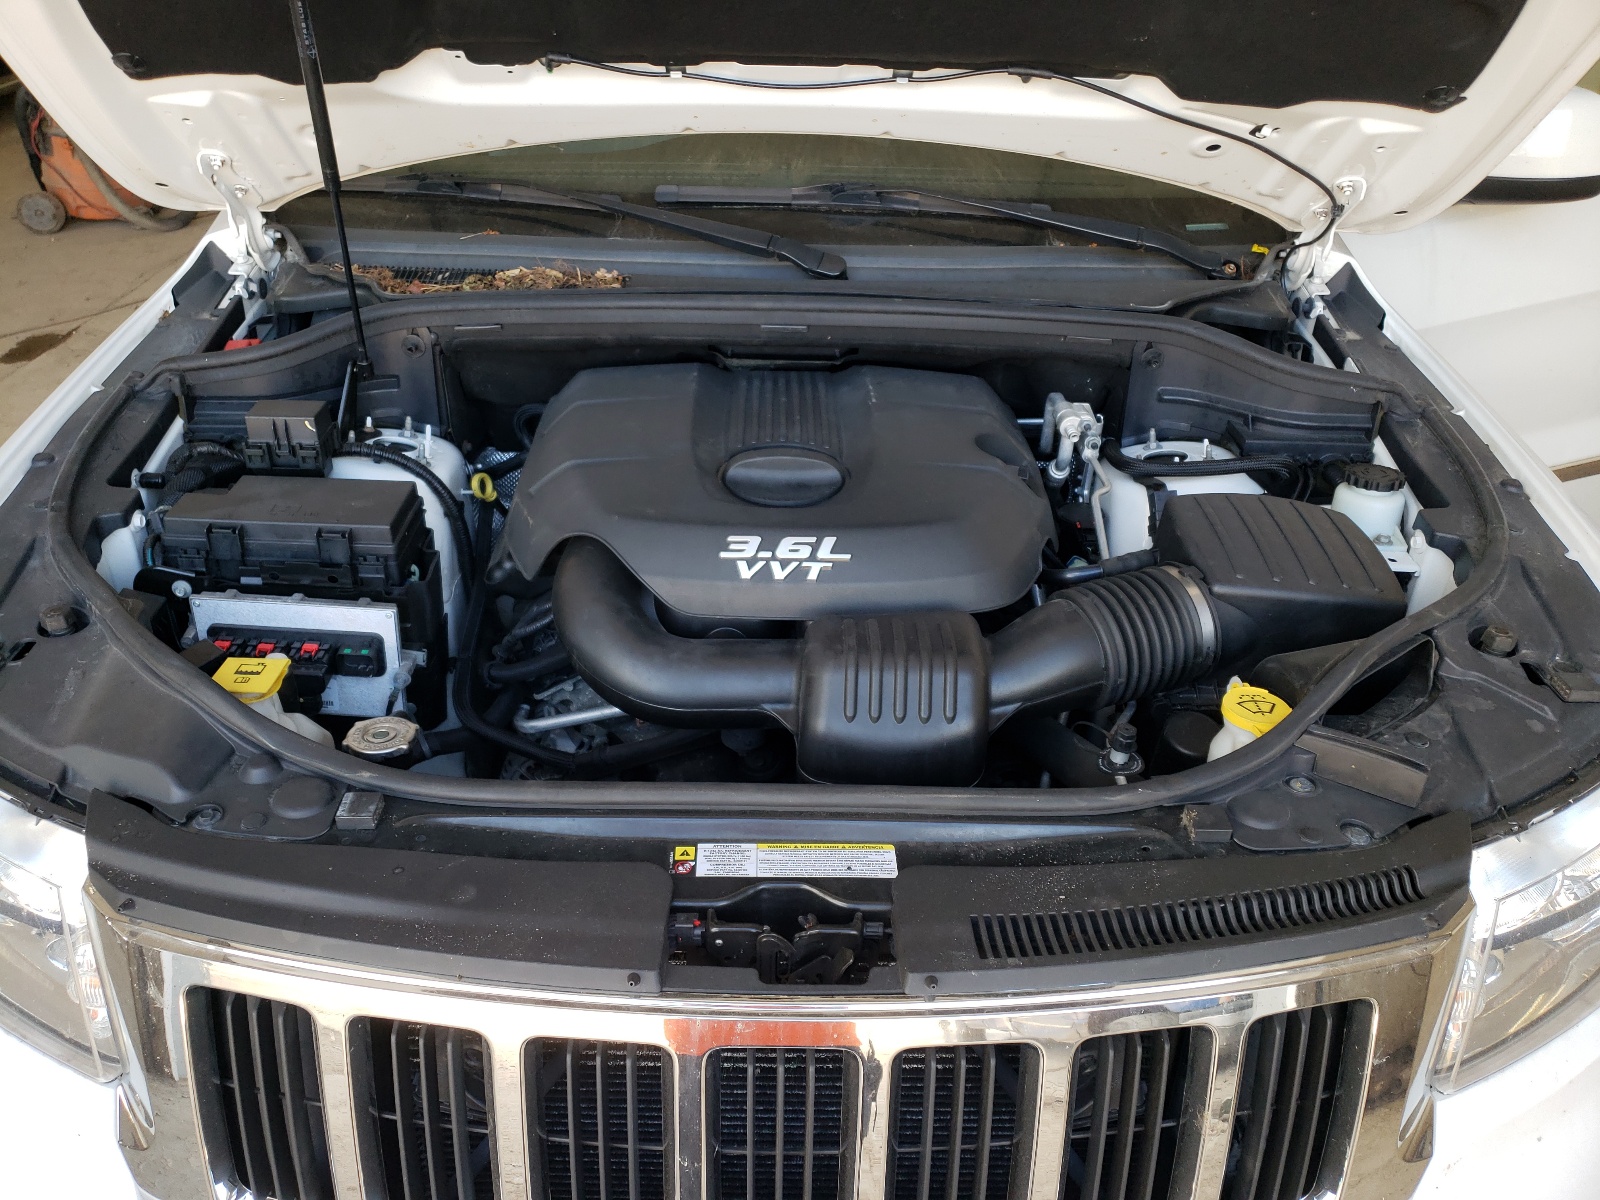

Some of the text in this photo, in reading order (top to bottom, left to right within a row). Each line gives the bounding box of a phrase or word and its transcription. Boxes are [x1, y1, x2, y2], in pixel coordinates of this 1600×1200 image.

[297, 1, 310, 46] STABILUS
[719, 535, 852, 561] 3.6L
[736, 560, 833, 582] VVT
